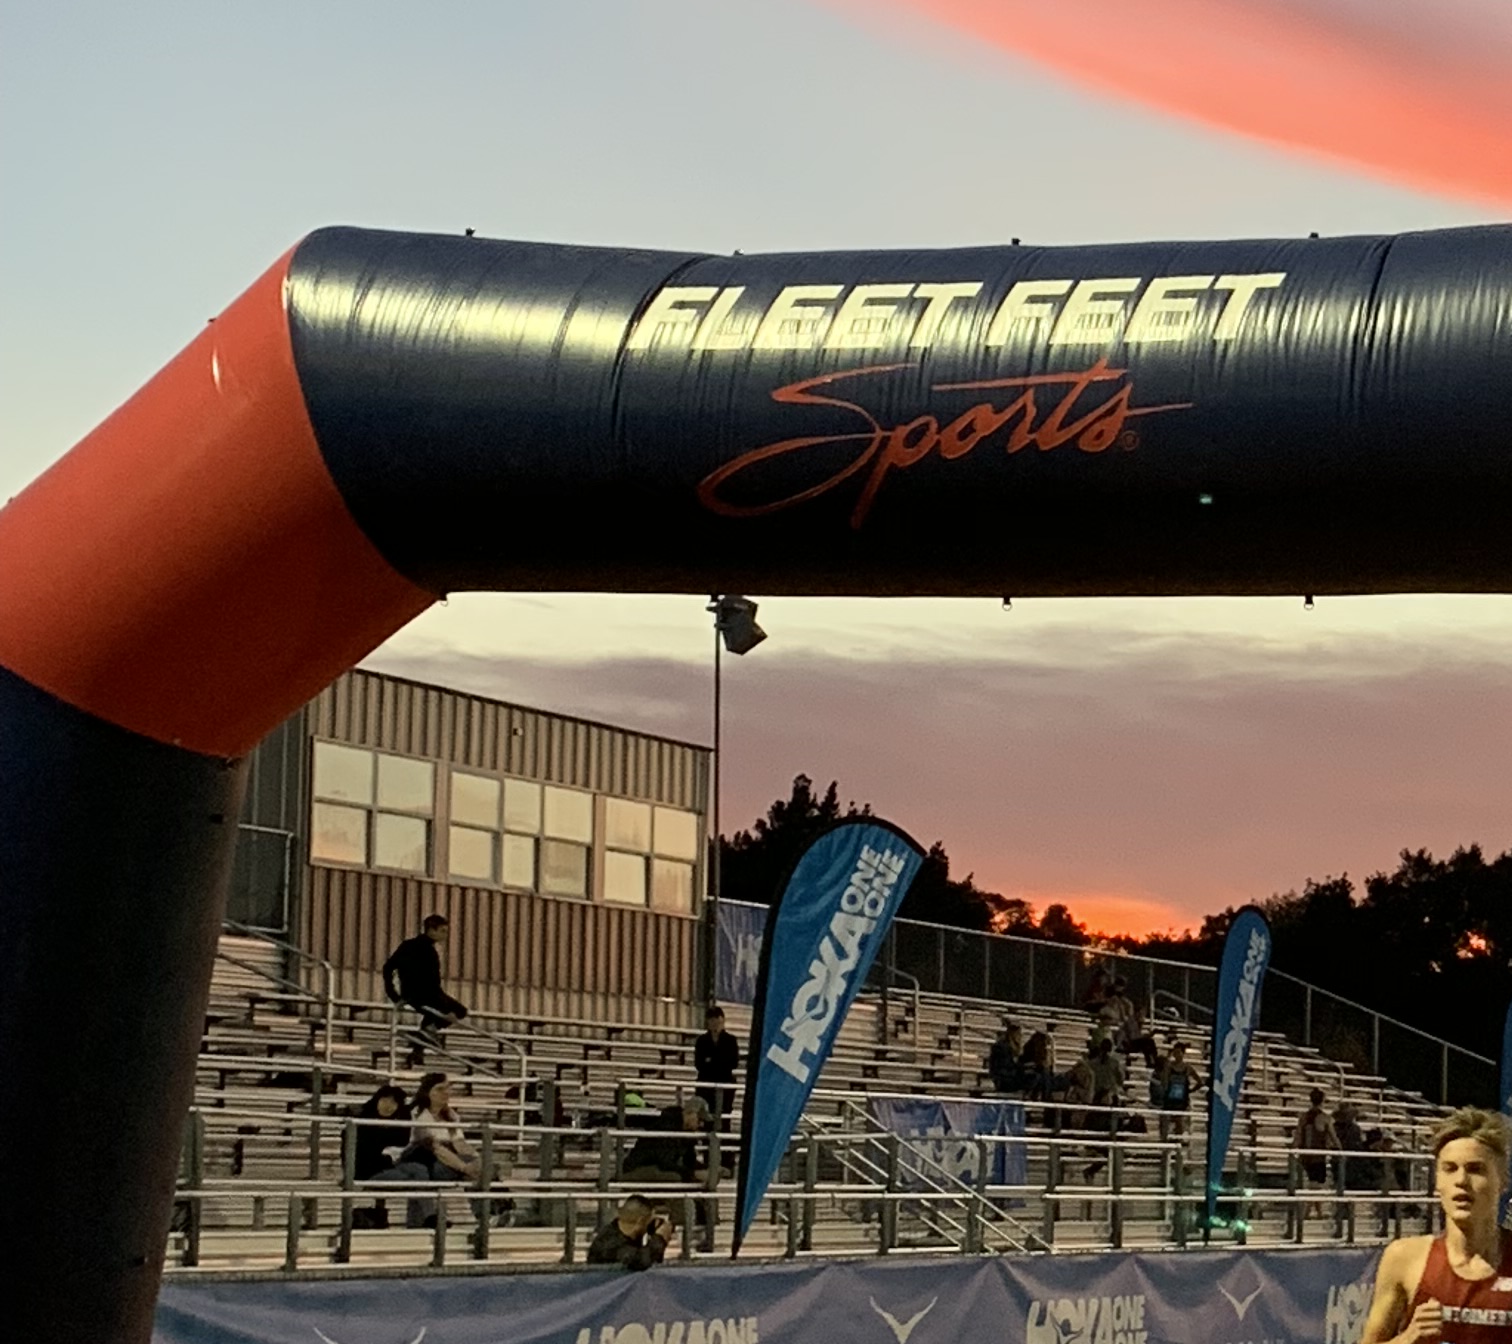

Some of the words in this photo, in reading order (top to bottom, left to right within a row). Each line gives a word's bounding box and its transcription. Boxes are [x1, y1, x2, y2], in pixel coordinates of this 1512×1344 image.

[625, 282, 983, 349] FLEET
[985, 272, 1287, 346] FEET
[697, 358, 1193, 529] Sports
[841, 844, 882, 914] ONE
[865, 848, 905, 918] ONE
[767, 911, 877, 1084] HOKA
[1113, 1295, 1145, 1332] ONE
